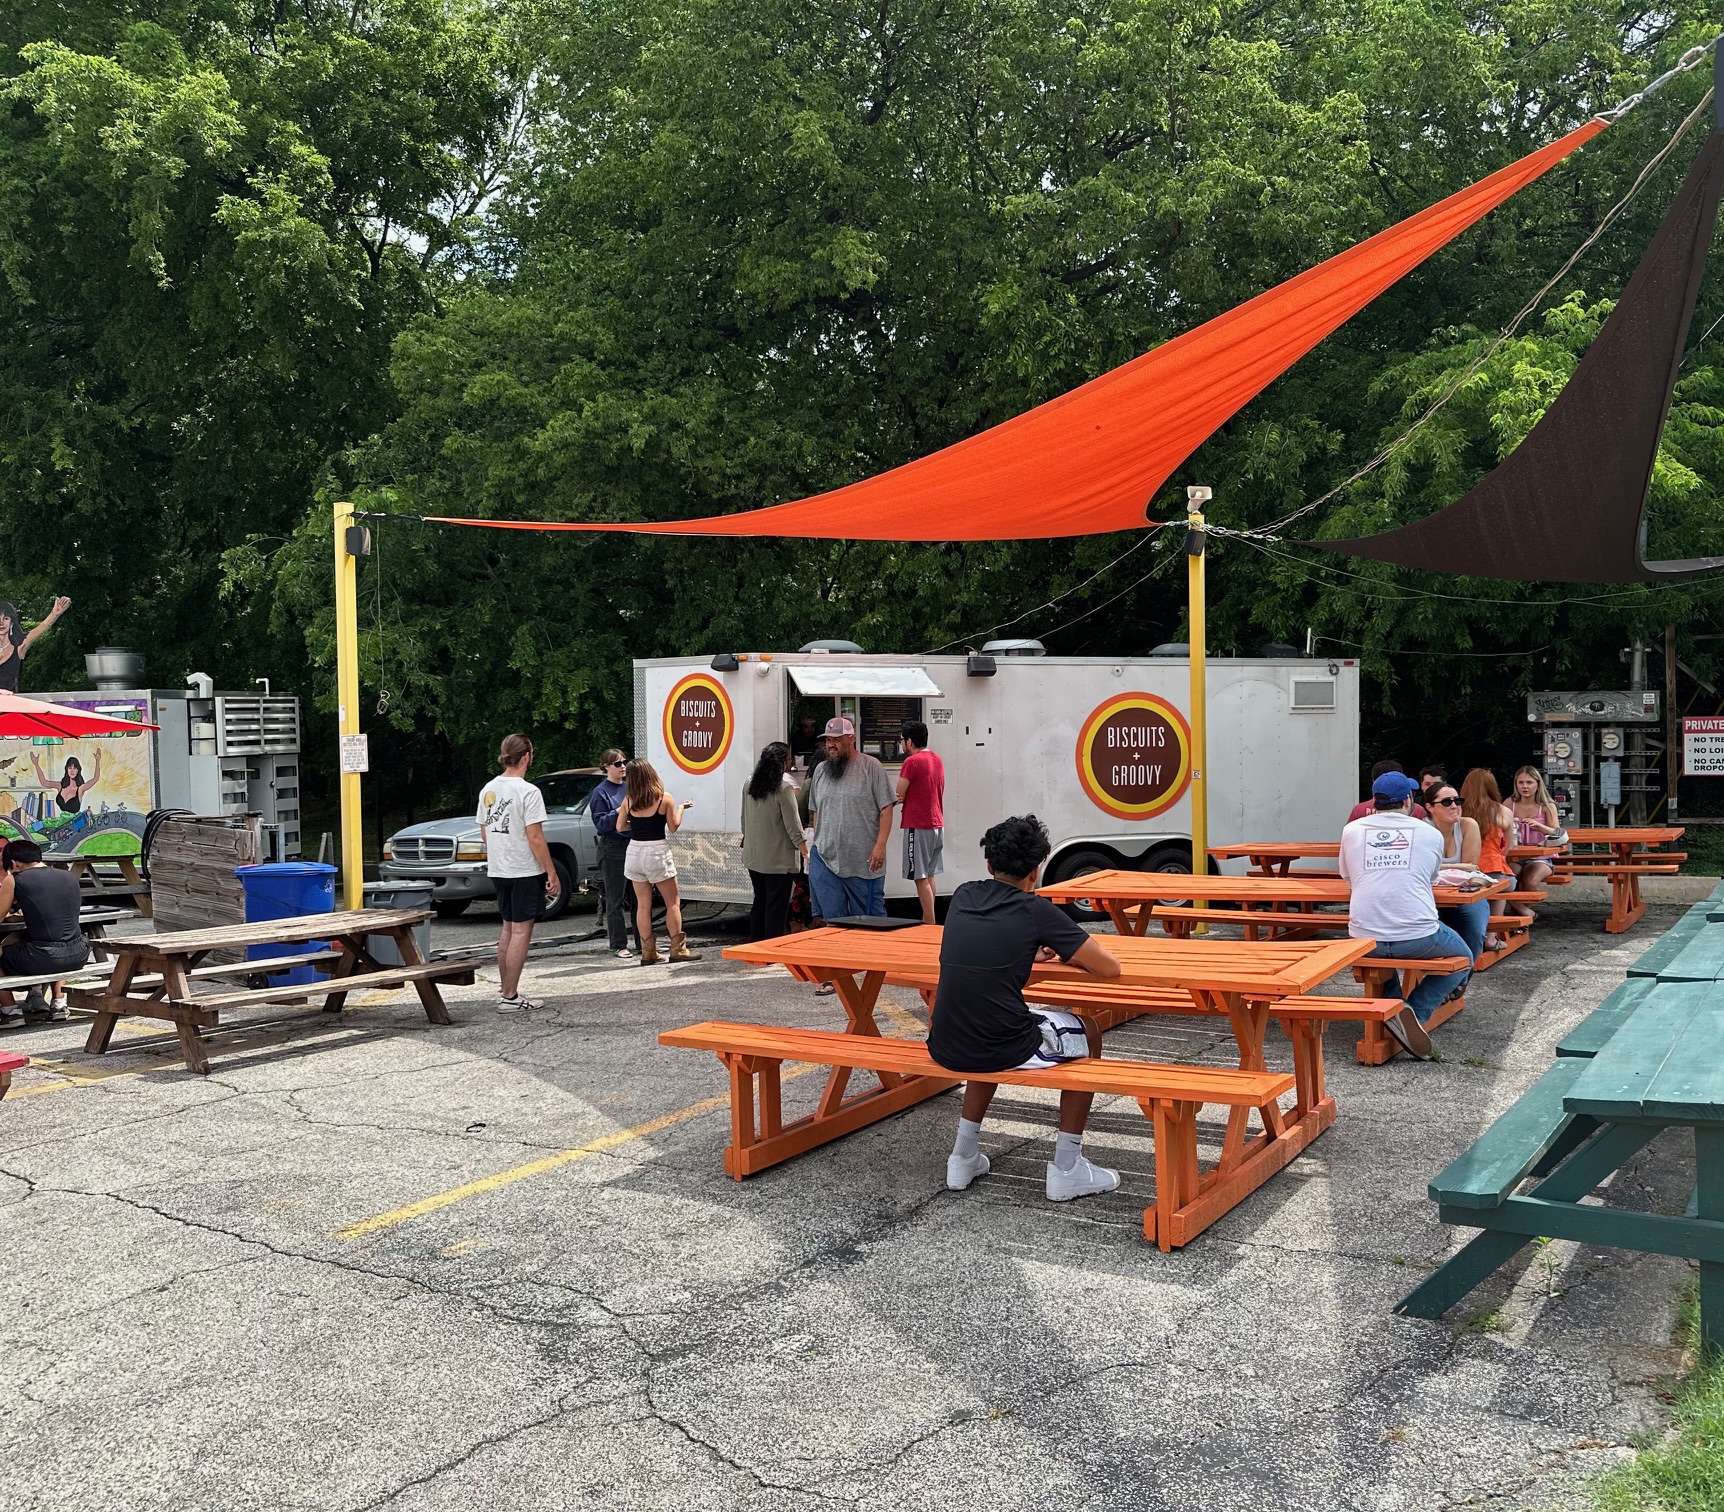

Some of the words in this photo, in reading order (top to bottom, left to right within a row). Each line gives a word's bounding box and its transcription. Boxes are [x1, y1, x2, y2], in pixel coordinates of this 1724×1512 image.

[680, 700, 716, 718] BISCUITS
[682, 730, 713, 748] GROOVY
[1107, 726, 1165, 748] BISCUITS
[1112, 765, 1161, 786] GROOVY
